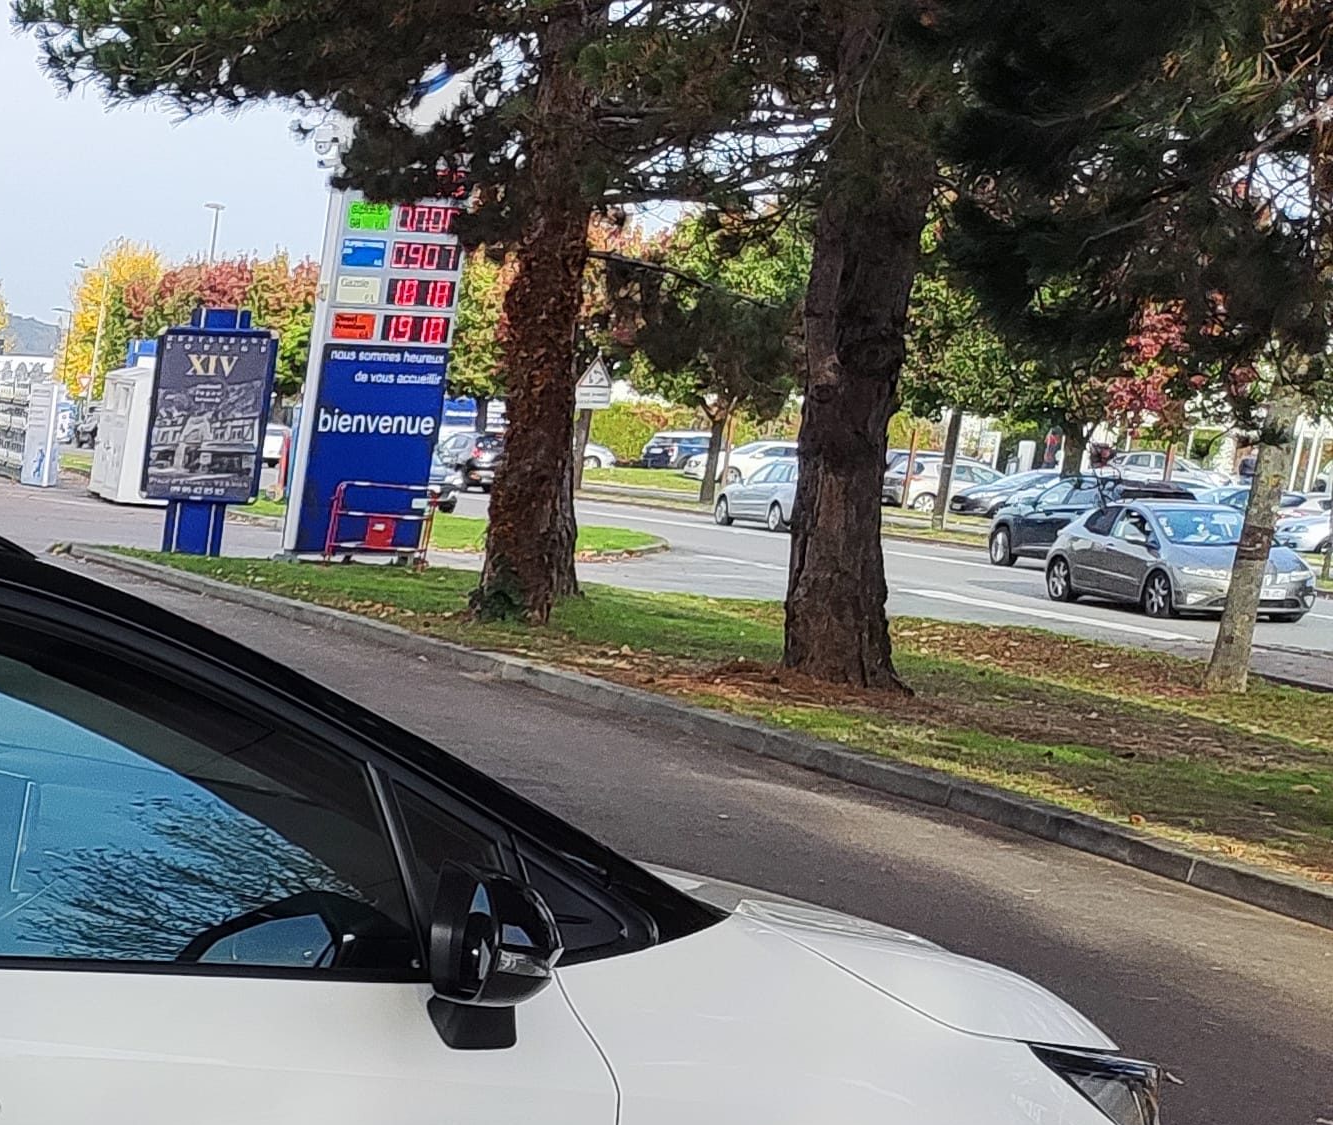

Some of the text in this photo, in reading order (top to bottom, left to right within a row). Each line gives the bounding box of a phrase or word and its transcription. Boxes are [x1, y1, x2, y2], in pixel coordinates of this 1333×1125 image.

[185, 353, 239, 378] XIV
[330, 350, 445, 364] nous sommes heureux
[354, 370, 442, 385] de vous accueillir
[317, 407, 435, 436] bienvenue
